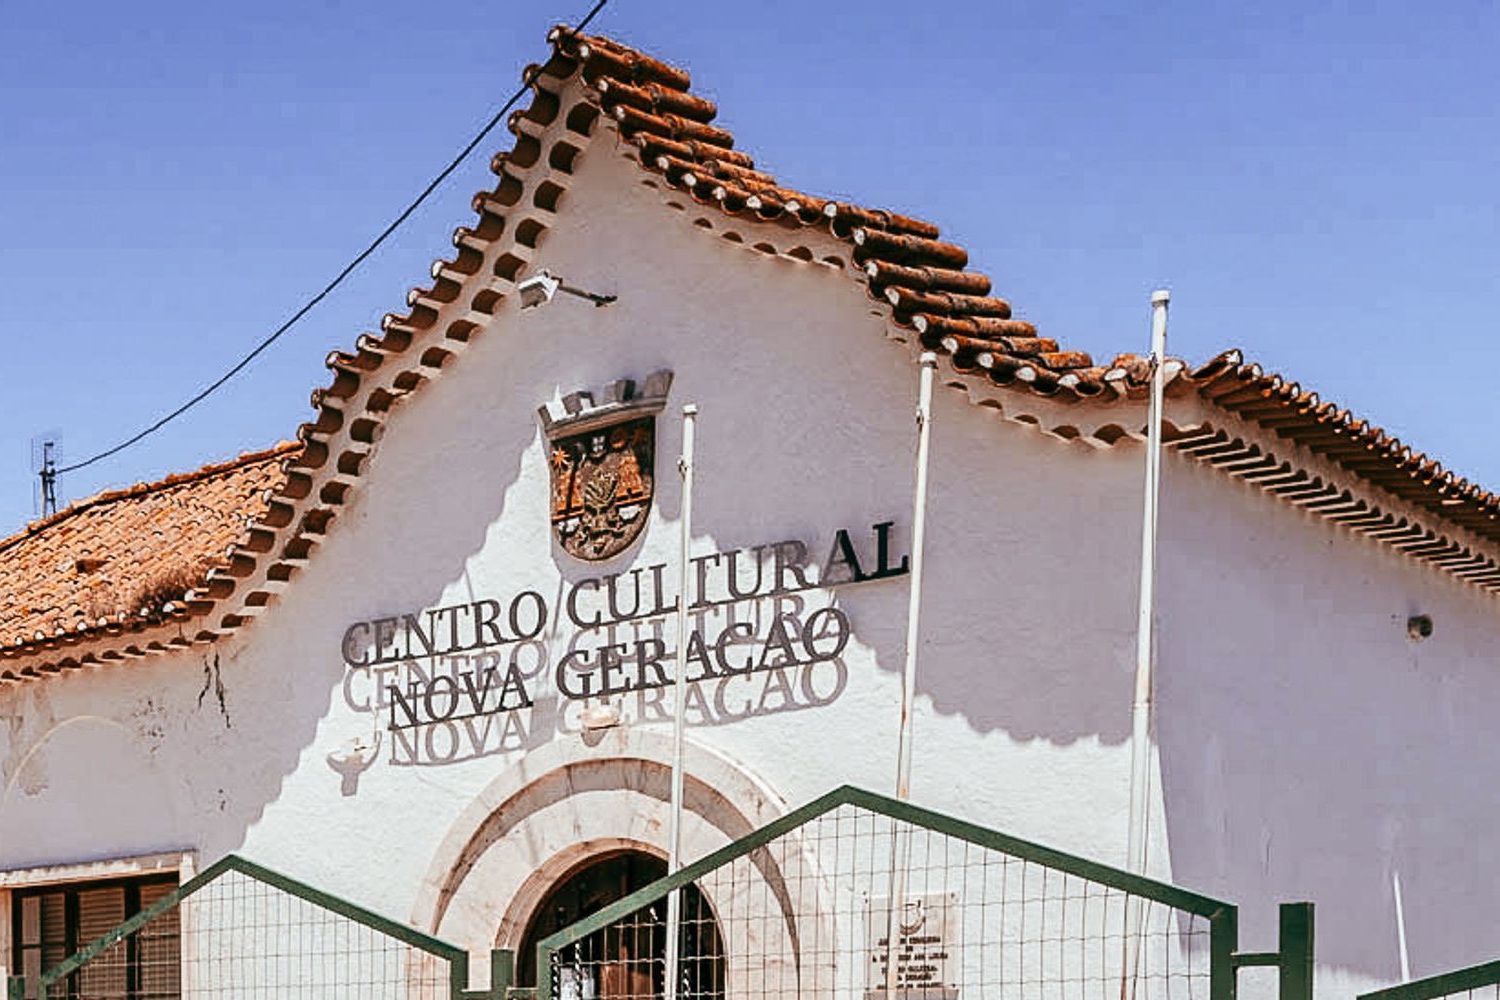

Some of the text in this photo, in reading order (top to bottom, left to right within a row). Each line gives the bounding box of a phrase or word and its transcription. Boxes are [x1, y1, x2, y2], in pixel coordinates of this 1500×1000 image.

[341, 521, 910, 669] CENTRO CULTURAL
[387, 607, 850, 731] NOVA GERACAO
